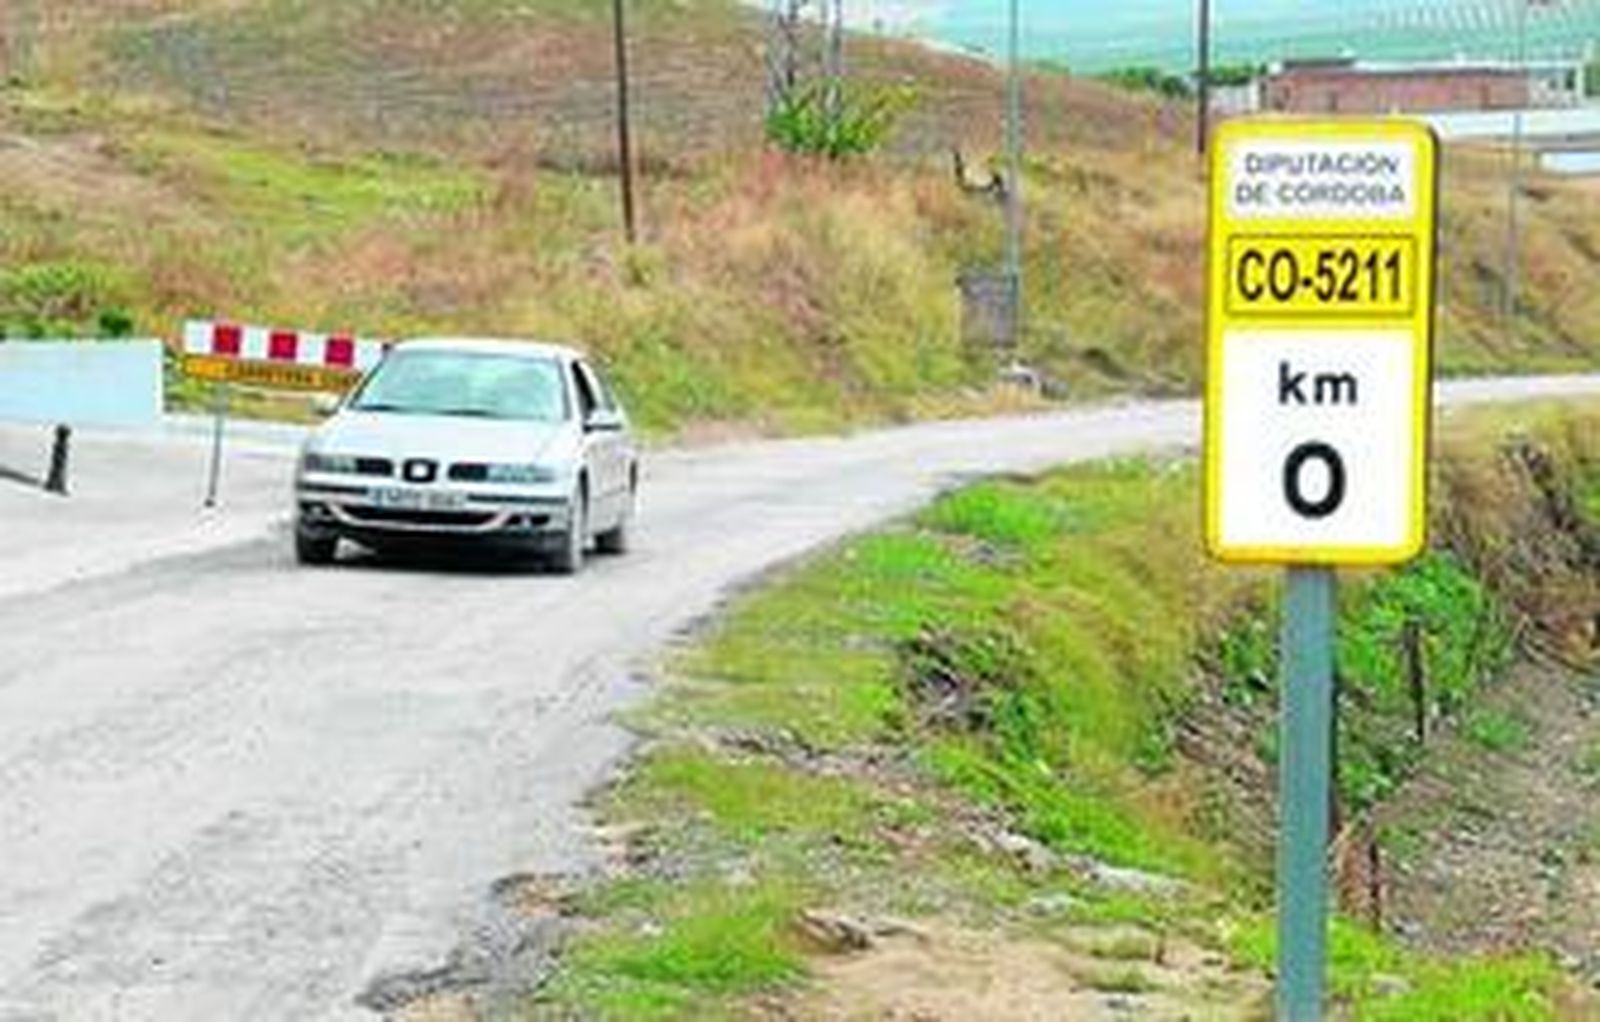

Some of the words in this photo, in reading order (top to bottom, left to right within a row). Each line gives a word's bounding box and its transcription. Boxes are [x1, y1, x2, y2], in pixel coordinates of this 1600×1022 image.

[1235, 183, 1269, 204] DE
[1237, 249, 1401, 302] CO-5211
[1278, 360, 1359, 405] km
[1282, 441, 1347, 520] 0
